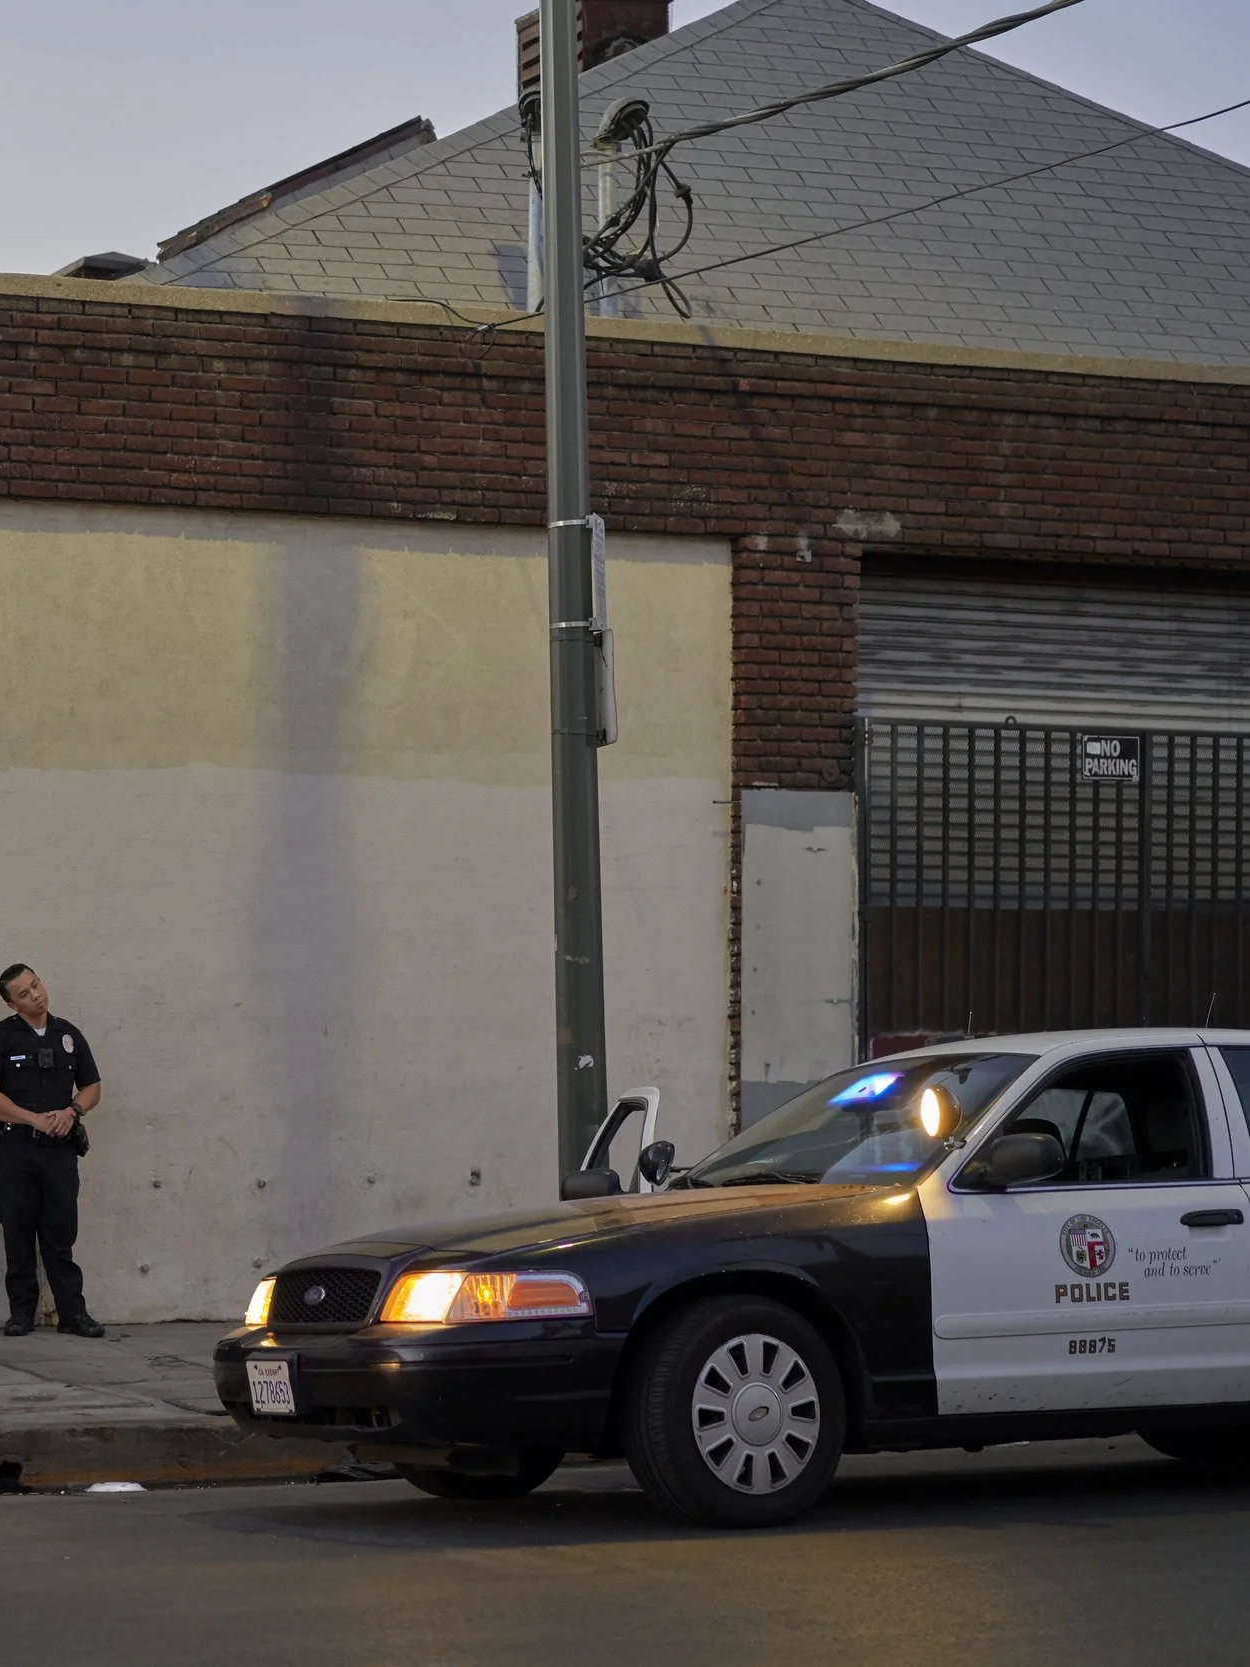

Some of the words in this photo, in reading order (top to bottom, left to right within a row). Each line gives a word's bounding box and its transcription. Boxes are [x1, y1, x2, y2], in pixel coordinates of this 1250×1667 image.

[1101, 740, 1121, 757] NO
[1085, 757, 1137, 776] PARKING
[1149, 1246, 1187, 1265] protect
[1144, 1262, 1166, 1279] and
[1170, 1263, 1180, 1277] to
[1054, 1281, 1130, 1304] POLICE
[1068, 1336, 1116, 1355] 88875
